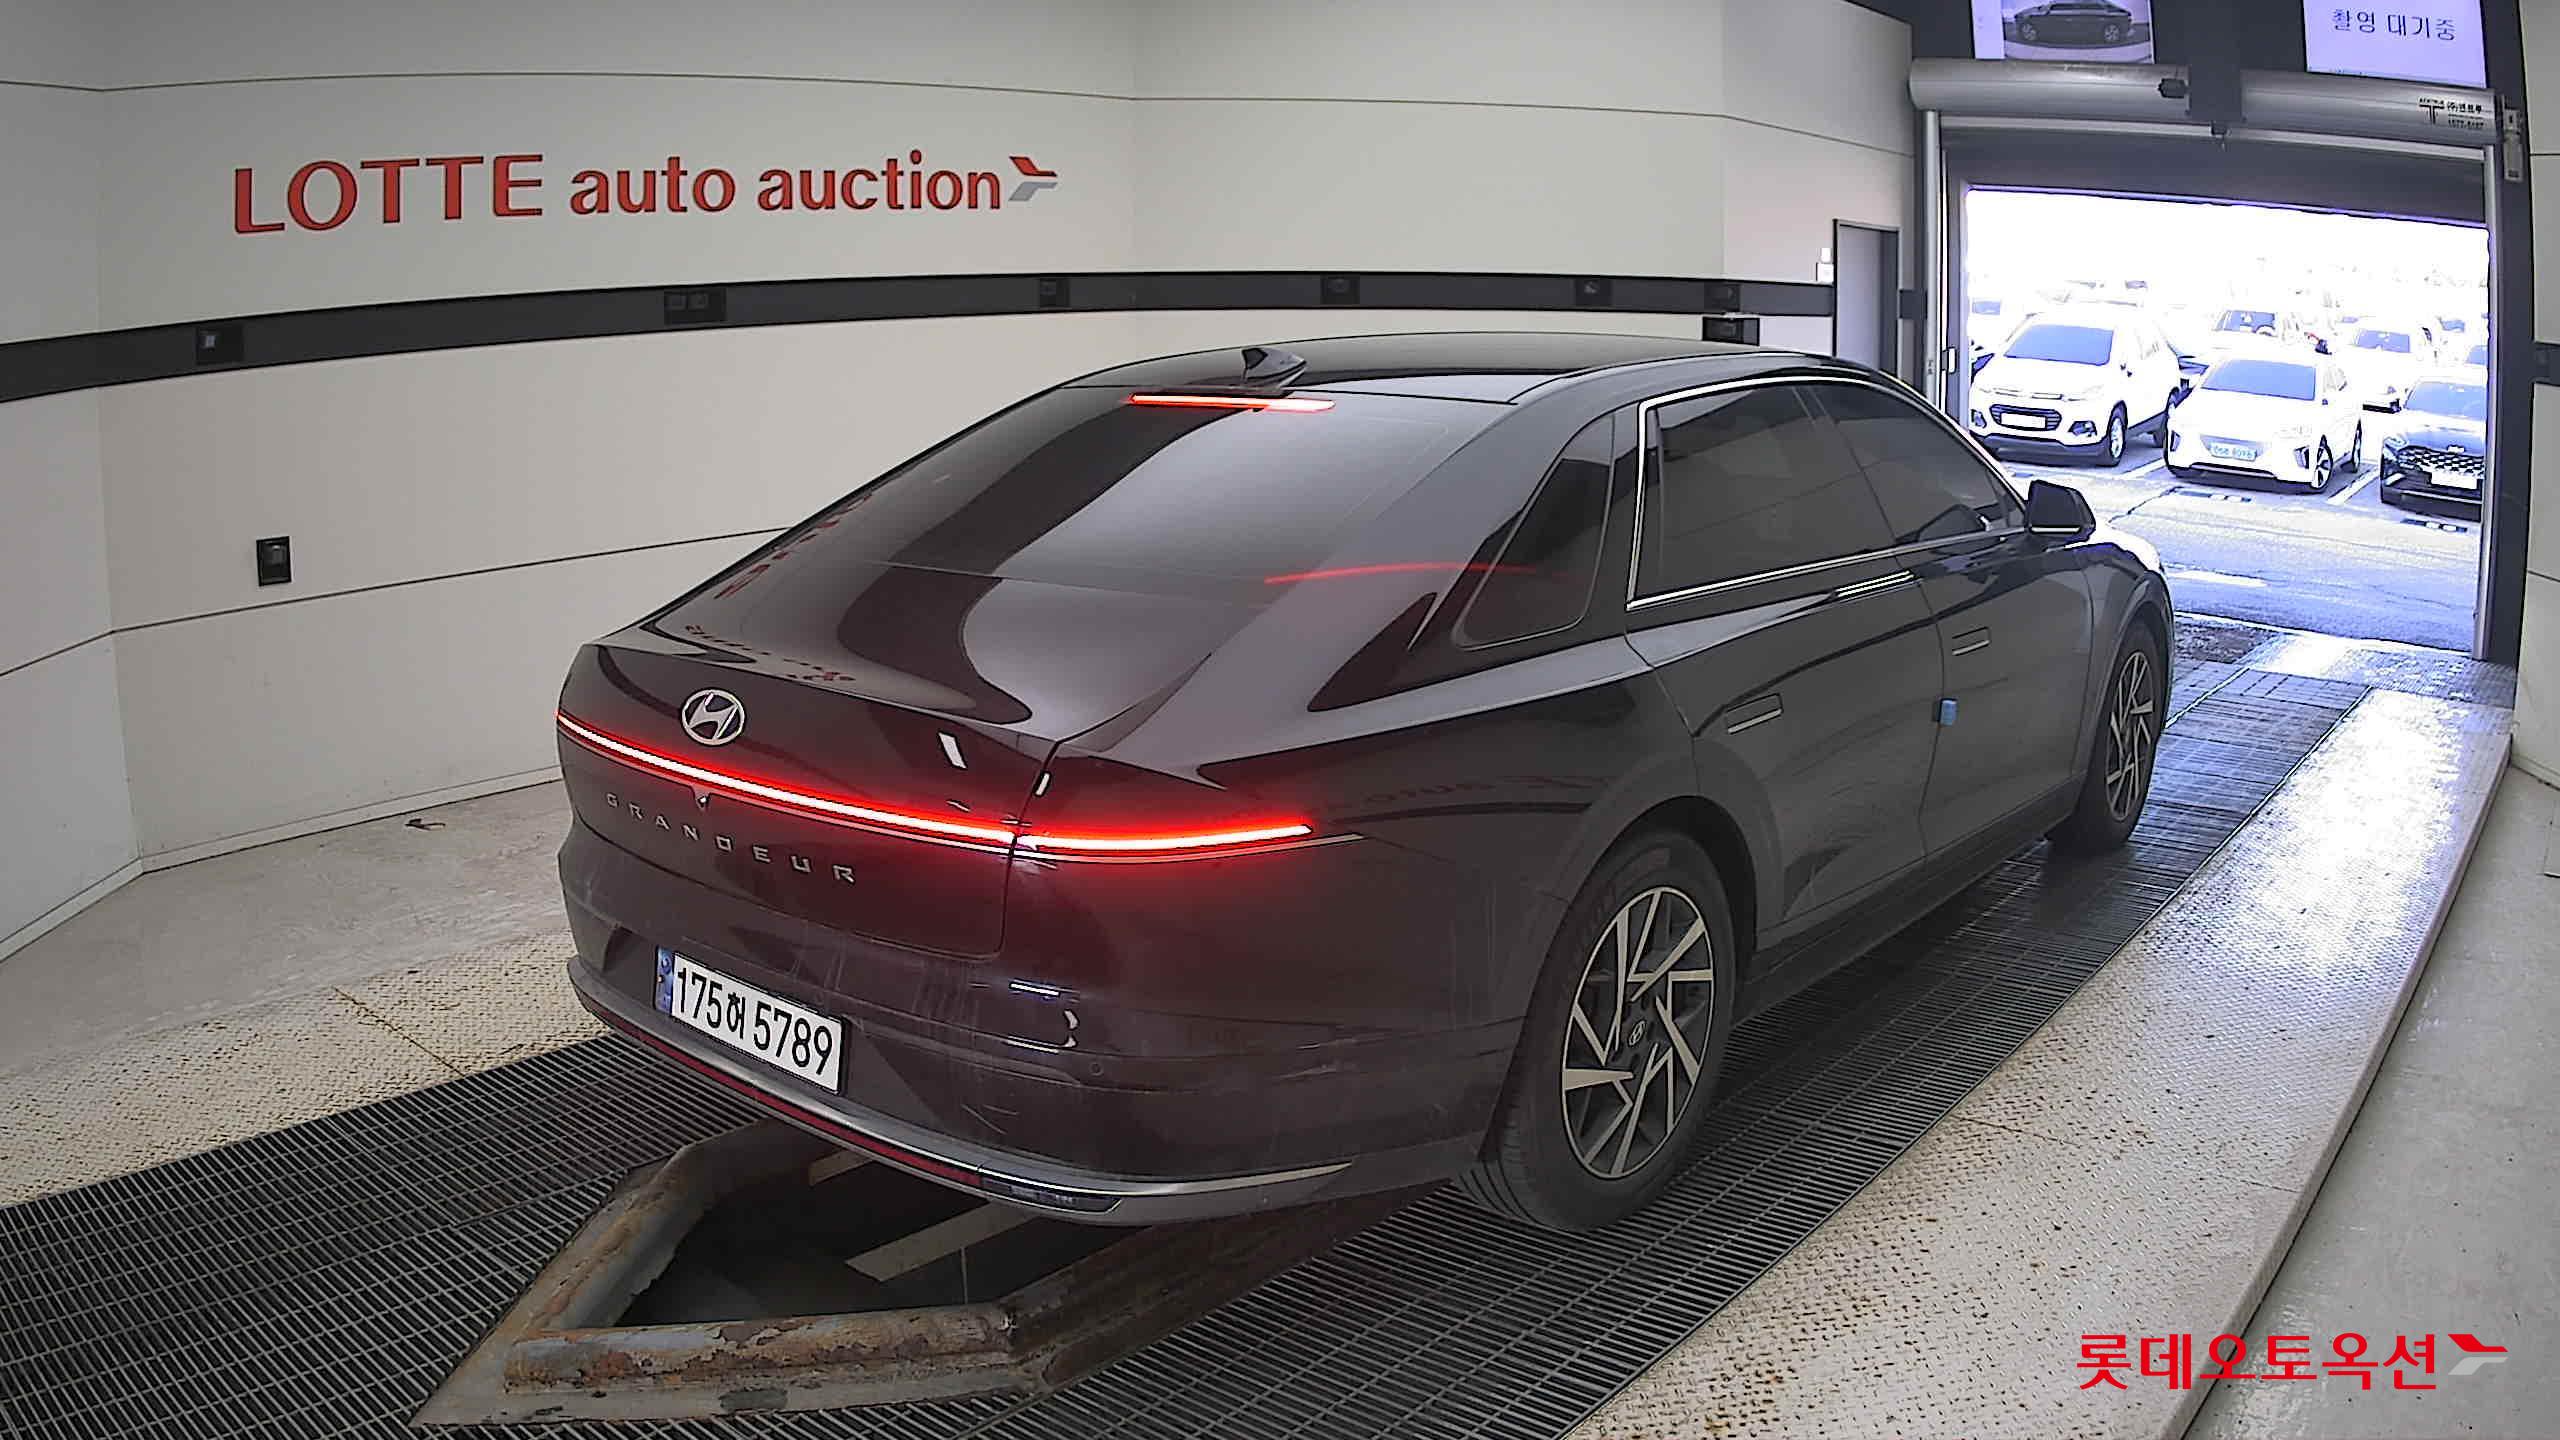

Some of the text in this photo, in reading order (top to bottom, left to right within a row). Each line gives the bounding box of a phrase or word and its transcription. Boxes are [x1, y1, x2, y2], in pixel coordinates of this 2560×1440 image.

[2387, 14, 2456, 42] 대기중
[235, 149, 1001, 234] LOTTE auto auction
[605, 792, 857, 884] GRANDEUR
[677, 967, 833, 1076] 175허 5789
